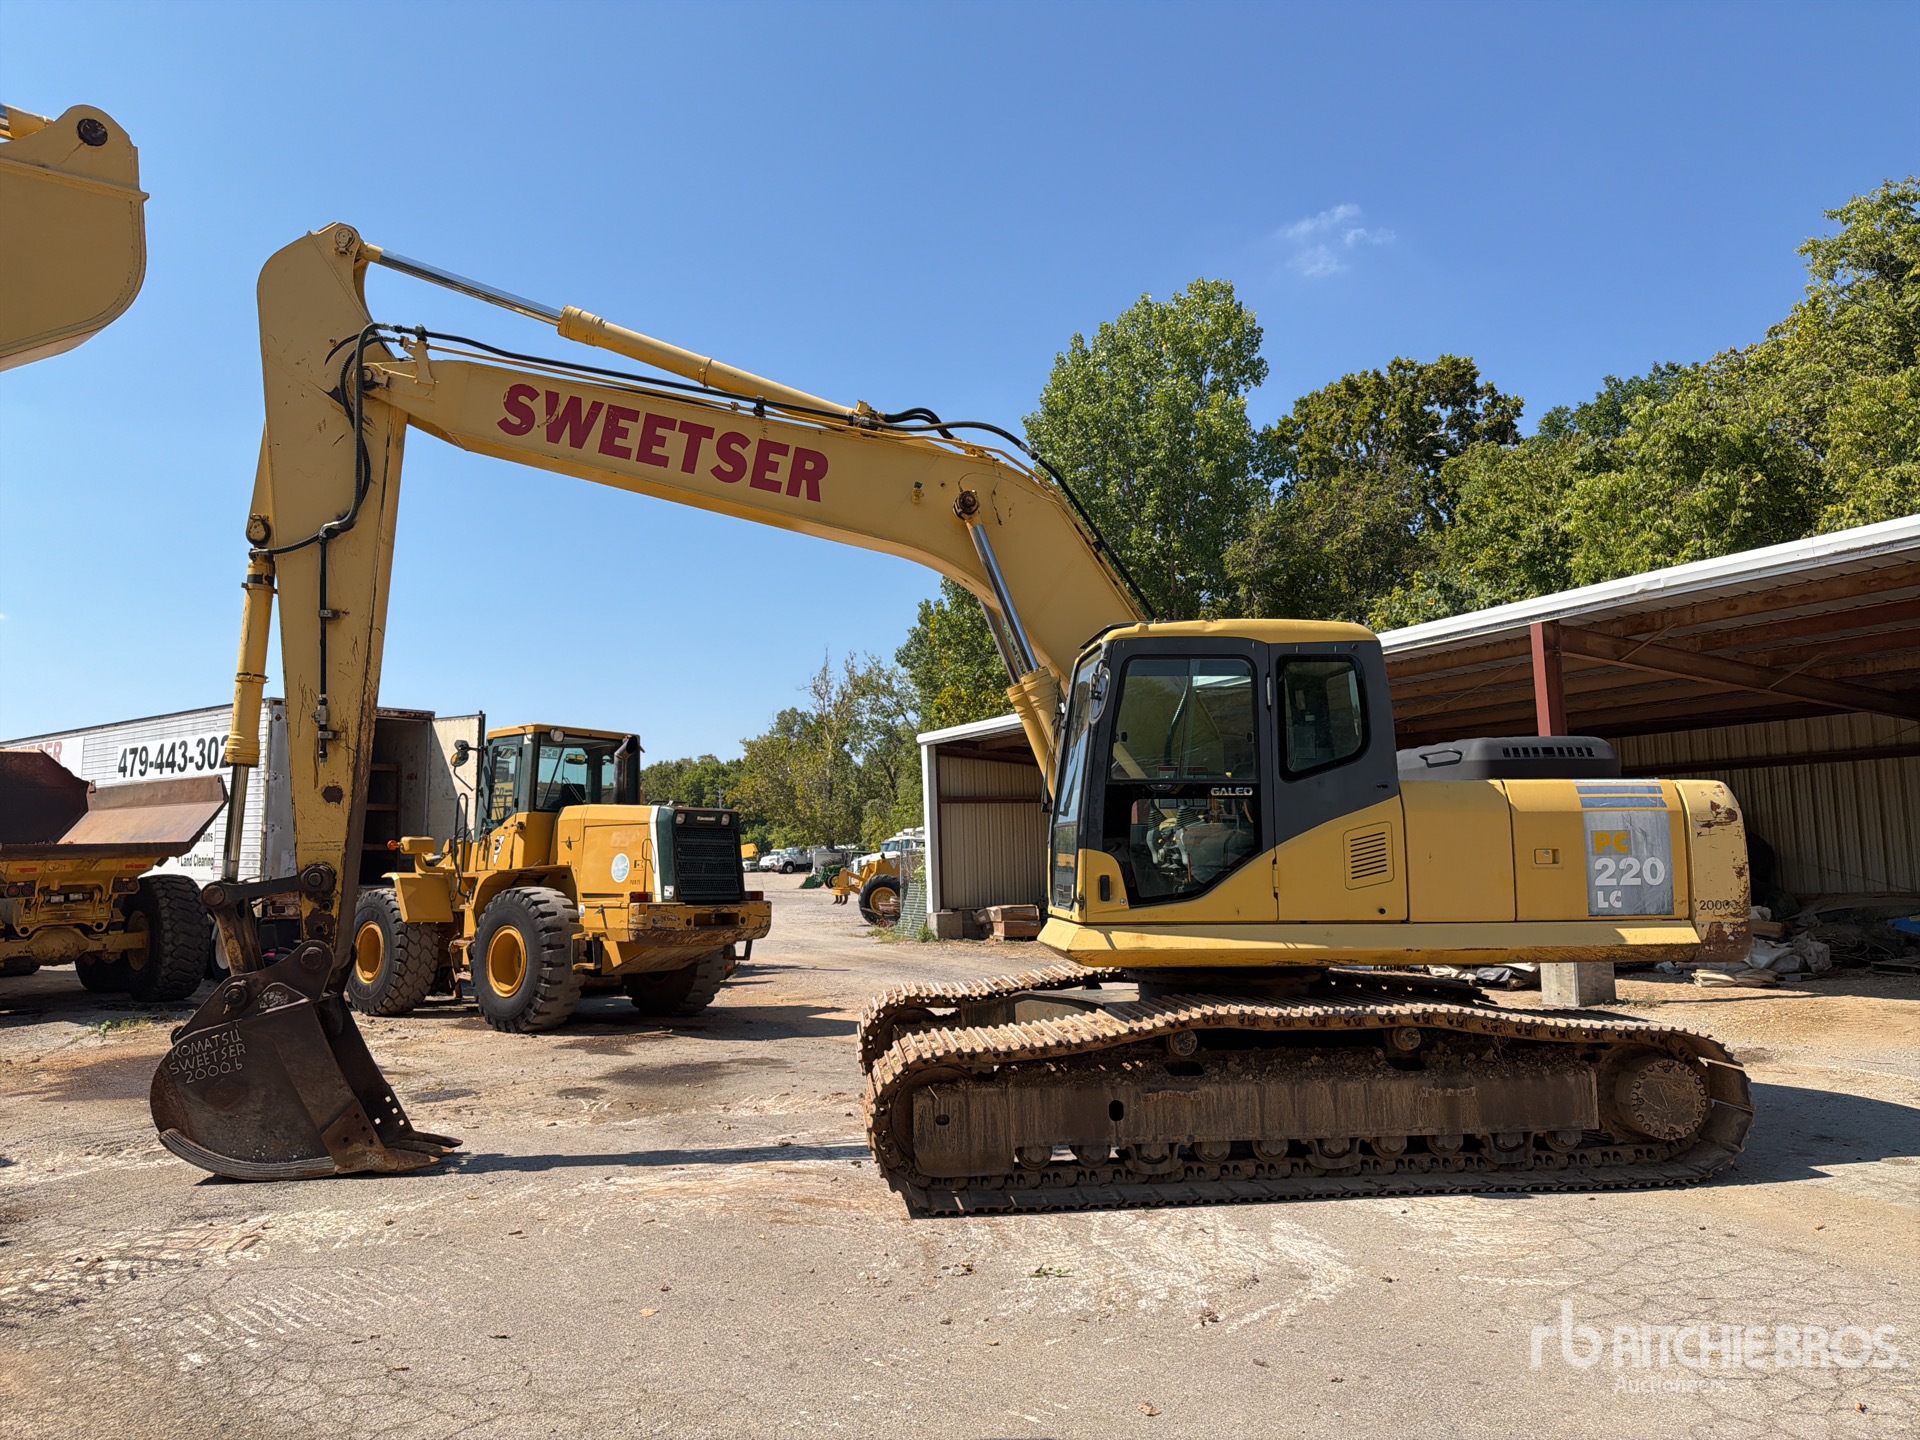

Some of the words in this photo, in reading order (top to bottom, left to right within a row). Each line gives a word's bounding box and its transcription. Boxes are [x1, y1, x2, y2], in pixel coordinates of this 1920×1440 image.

[497, 383, 829, 503] SWEETSER
[1210, 786, 1254, 797] GALEO
[1593, 831, 1630, 854] PC
[1594, 857, 1666, 886] 220
[1596, 890, 1623, 908] LC
[169, 1042, 246, 1075] SWEETSER
[171, 1028, 243, 1060] KOMATSU
